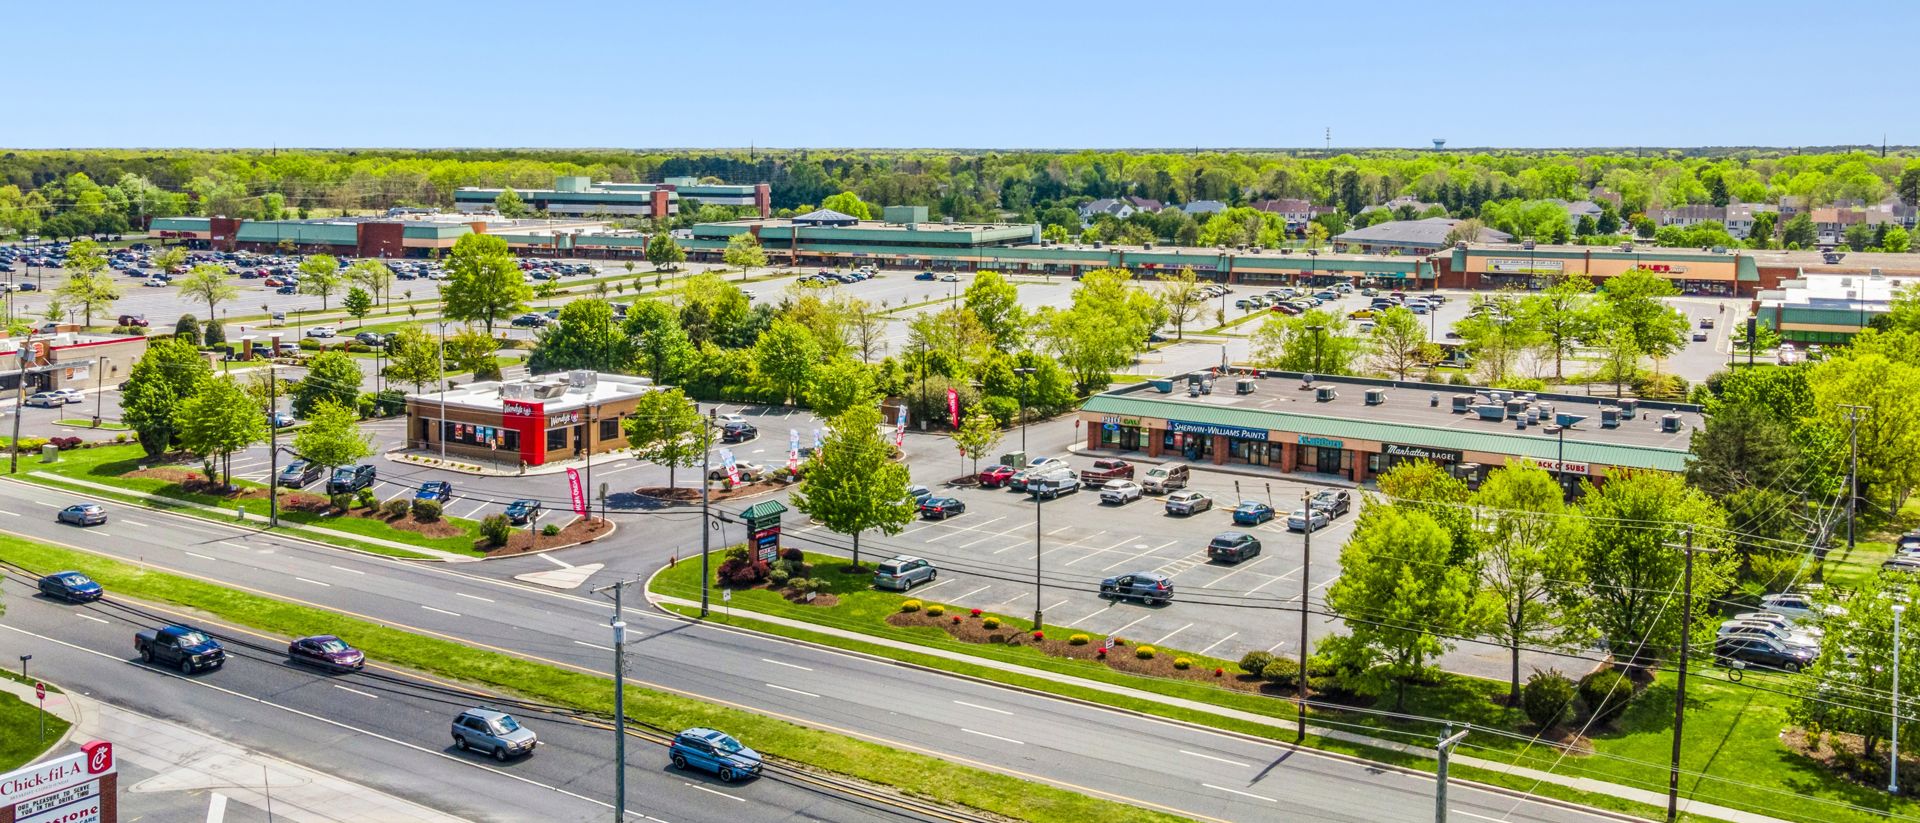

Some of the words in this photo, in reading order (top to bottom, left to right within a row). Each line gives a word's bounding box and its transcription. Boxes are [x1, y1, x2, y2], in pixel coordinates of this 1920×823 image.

[550, 413, 571, 427] Wendy's
[1241, 429, 1265, 440] PAINTS
[1386, 444, 1430, 458] Manhattan
[1431, 452, 1455, 461] BAGEL
[1565, 464, 1585, 472] SUBS
[0, 761, 81, 796] Chick-fil-A
[32, 793, 60, 807] PLEASURE
[73, 784, 90, 794] SERVE
[21, 807, 33, 816] YOU
[45, 801, 55, 809] THE
[58, 794, 74, 805] DRIVE
